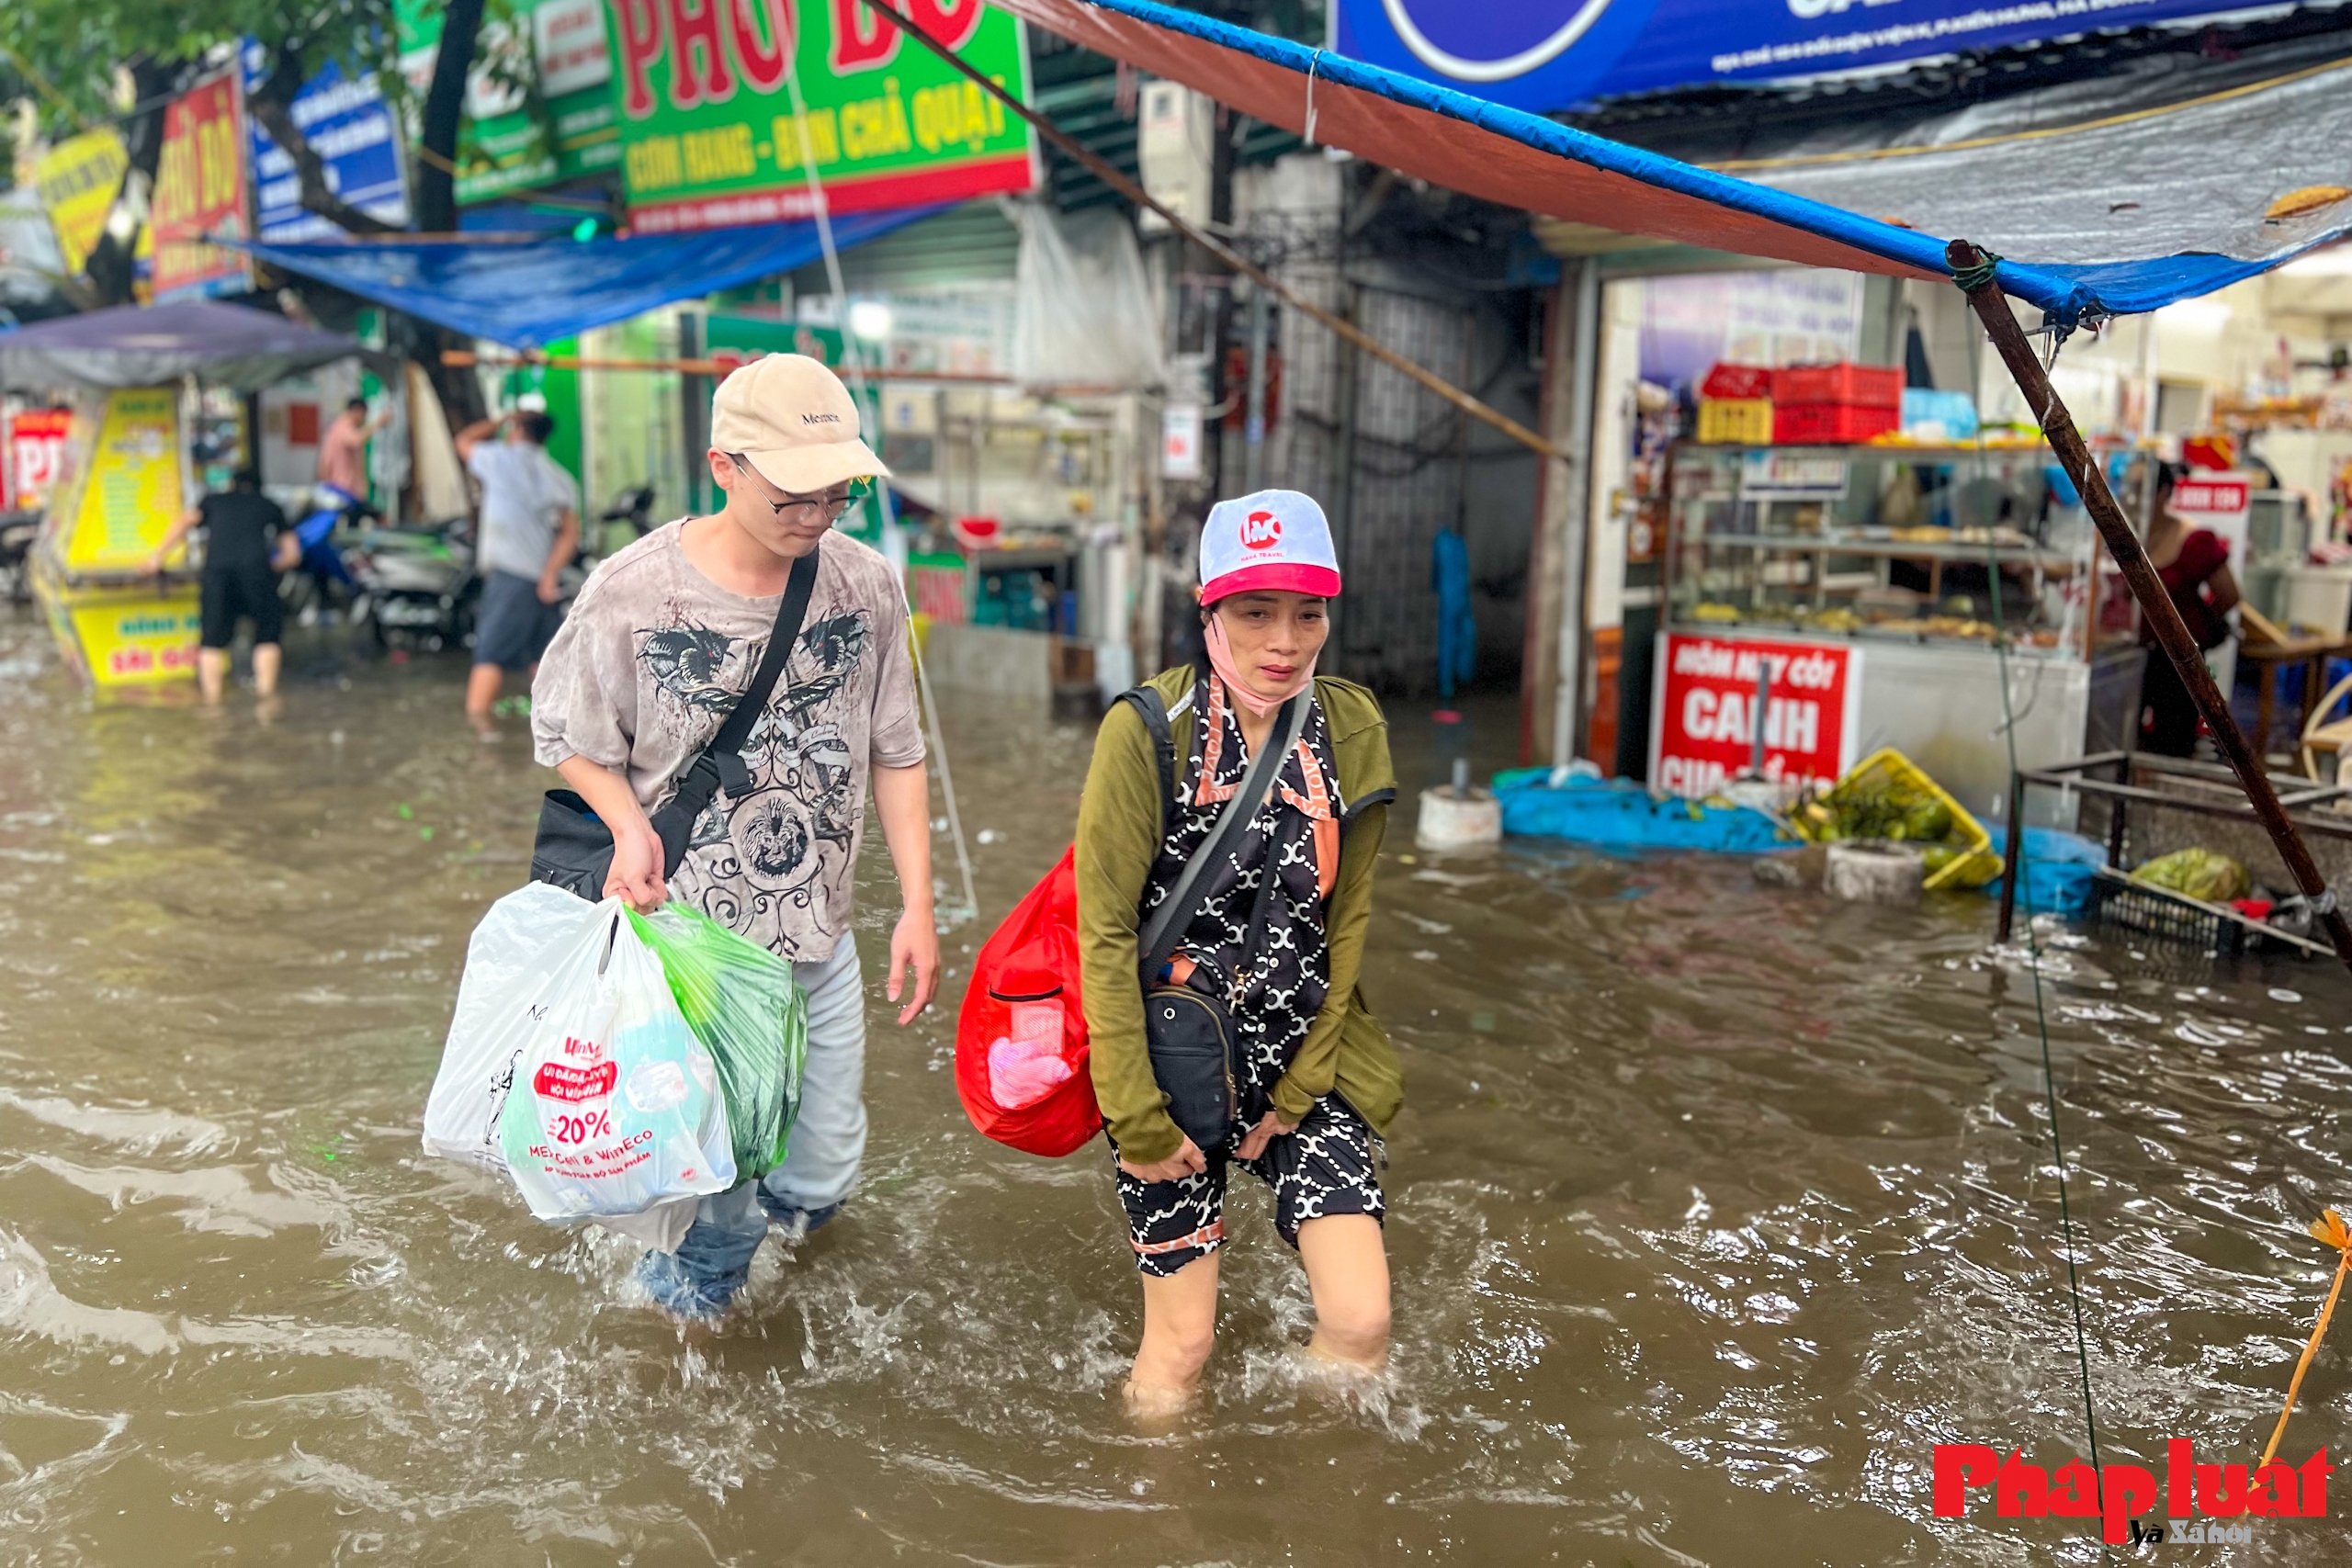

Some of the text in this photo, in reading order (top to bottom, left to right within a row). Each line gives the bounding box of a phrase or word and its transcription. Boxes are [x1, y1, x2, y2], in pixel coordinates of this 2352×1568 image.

[1682, 688, 1819, 754] CANH
[583, 1154, 594, 1166] &
[595, 1130, 653, 1160] WinEco
